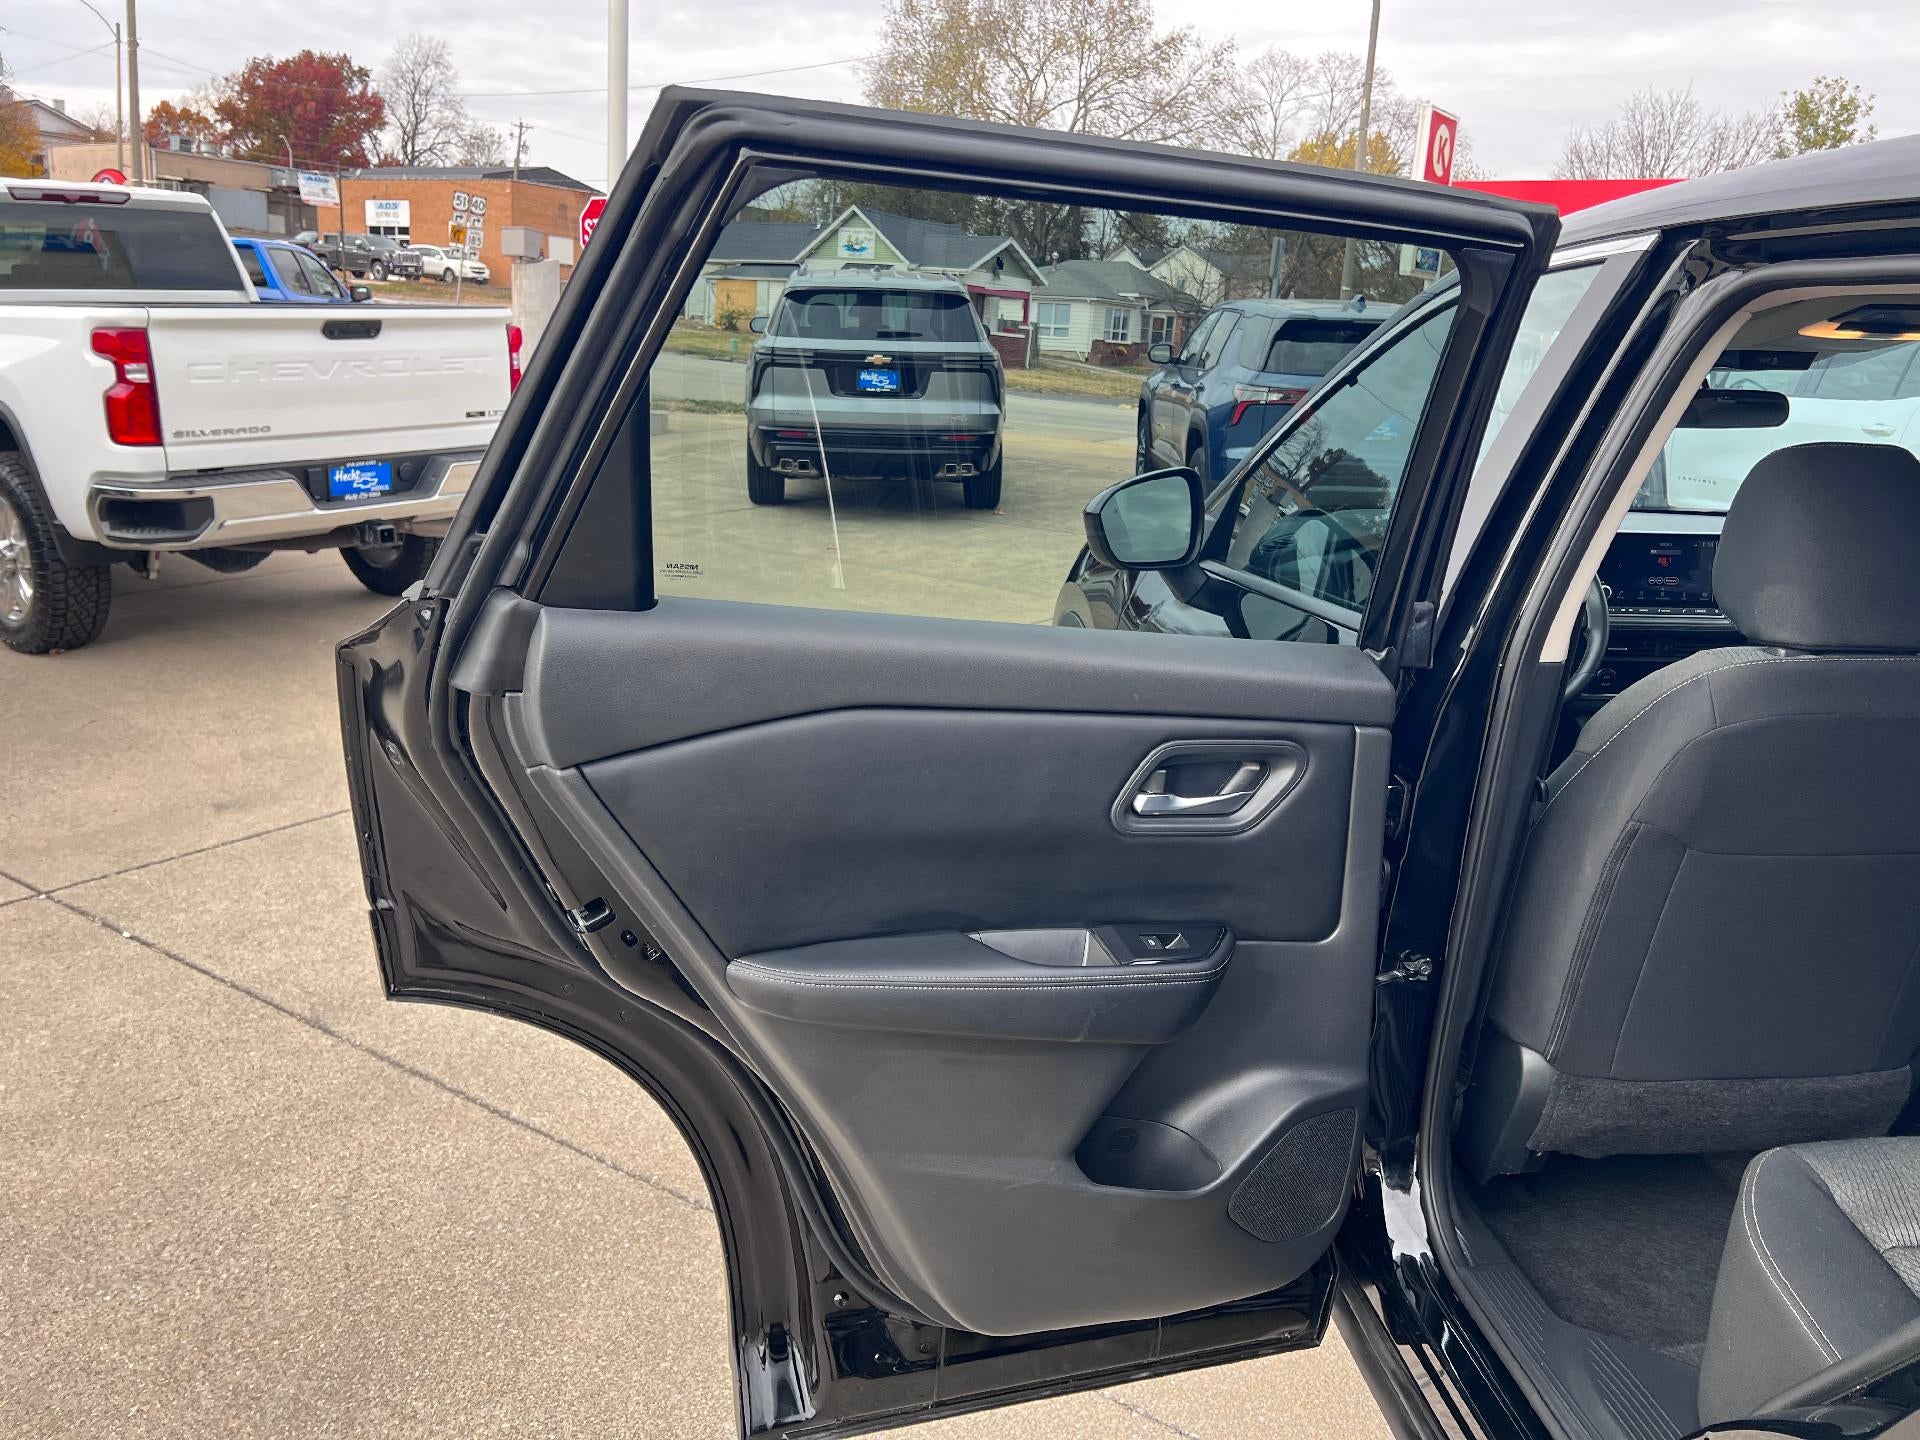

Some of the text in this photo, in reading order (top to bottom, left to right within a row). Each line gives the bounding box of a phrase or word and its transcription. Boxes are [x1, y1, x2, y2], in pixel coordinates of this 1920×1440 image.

[1437, 134, 1448, 174] K
[456, 194, 467, 208] 51
[472, 199, 486, 212] 40
[187, 353, 491, 384] CHEVROLET
[172, 425, 271, 439] SILVERADO
[333, 468, 361, 483] Hecht
